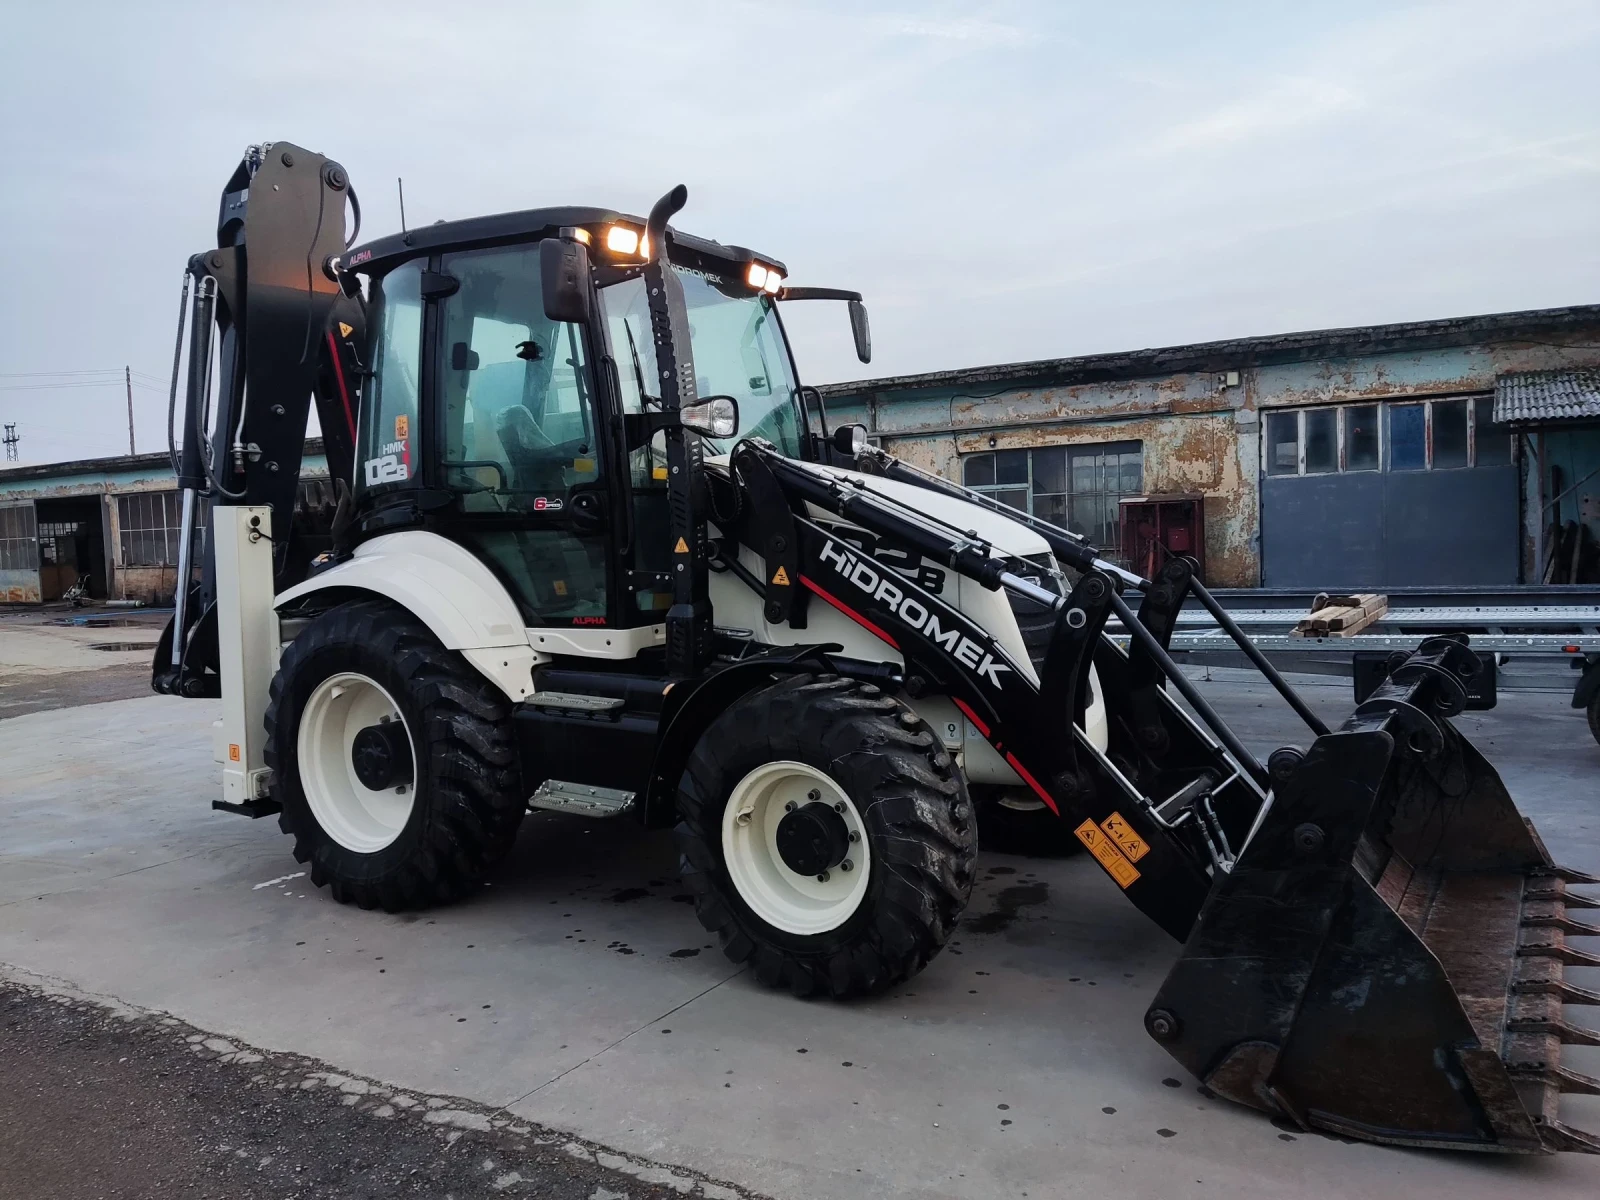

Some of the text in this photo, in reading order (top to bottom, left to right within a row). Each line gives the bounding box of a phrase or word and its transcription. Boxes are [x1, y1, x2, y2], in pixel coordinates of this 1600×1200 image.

[350, 249, 372, 265] ALPHA
[382, 440, 407, 455] HMK
[572, 615, 606, 625] ALPHA
